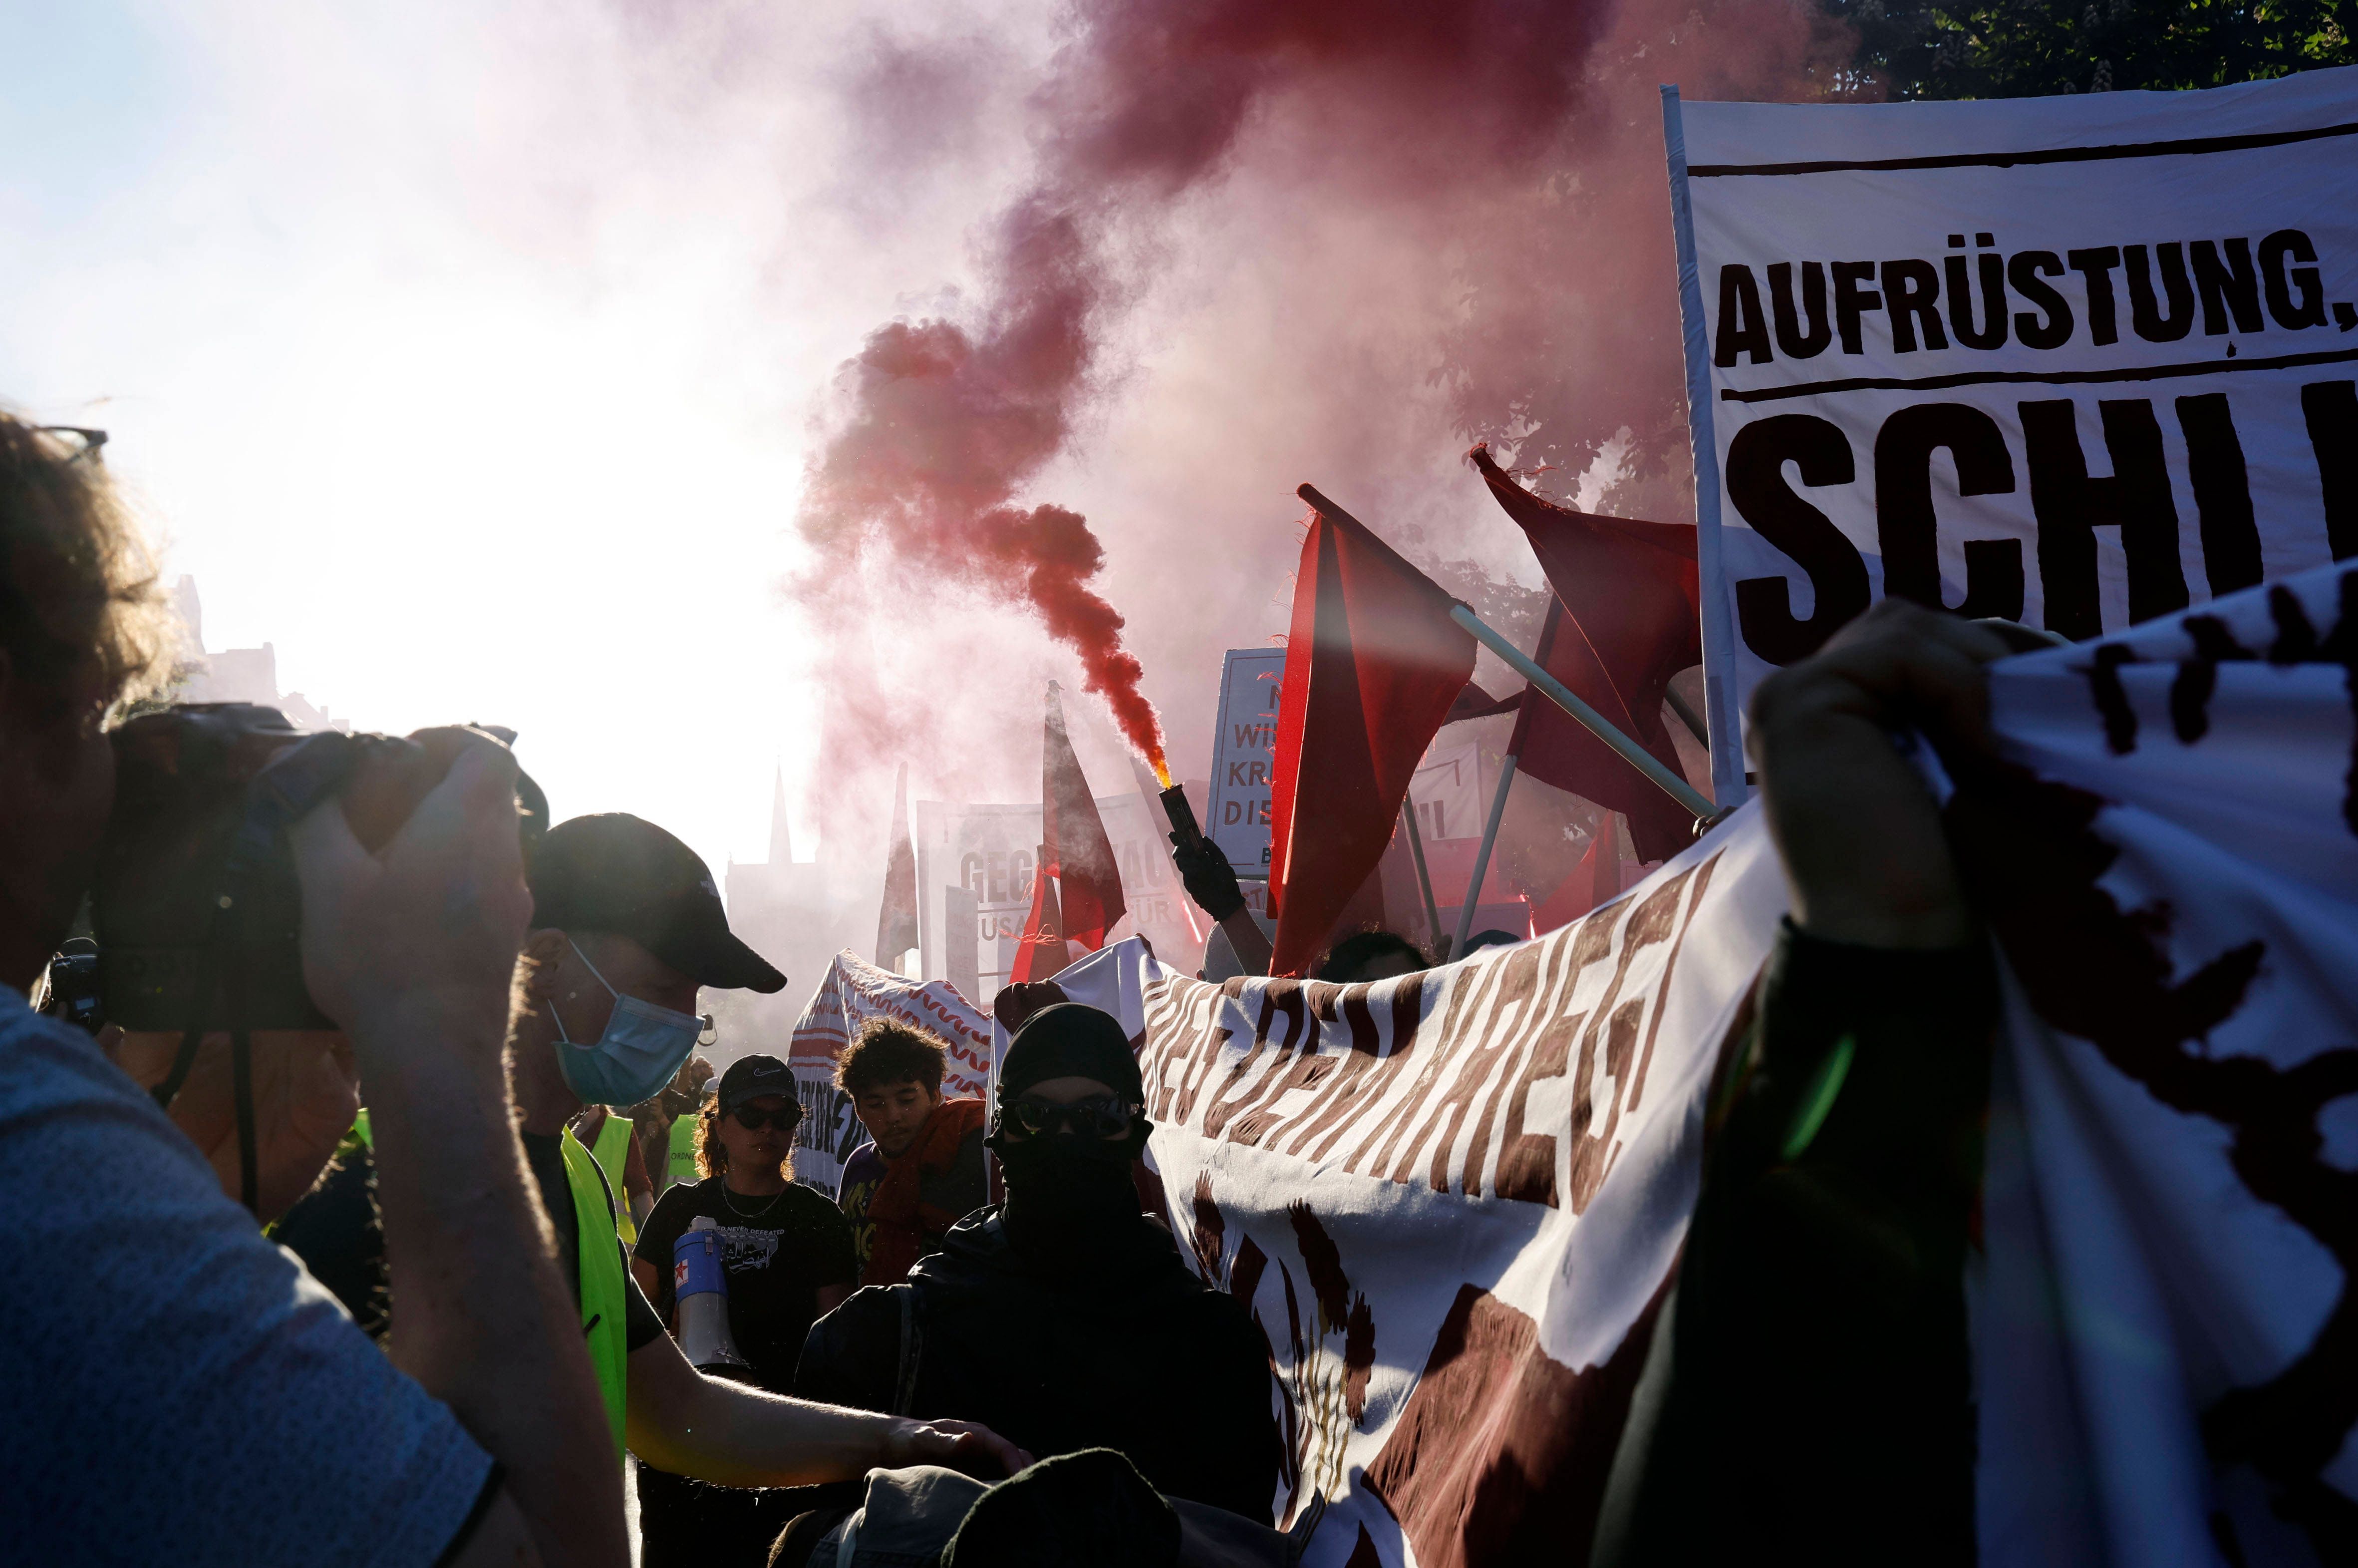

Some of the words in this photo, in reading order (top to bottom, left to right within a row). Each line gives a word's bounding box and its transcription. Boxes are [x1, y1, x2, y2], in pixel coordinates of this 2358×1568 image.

[1715, 229, 2358, 368] AUFRÜSTUNG,
[1234, 723, 1278, 749] WI
[1224, 800, 1272, 825] DIE
[1203, 972, 1428, 1163] DEM
[671, 1152, 696, 1161] ORDNE
